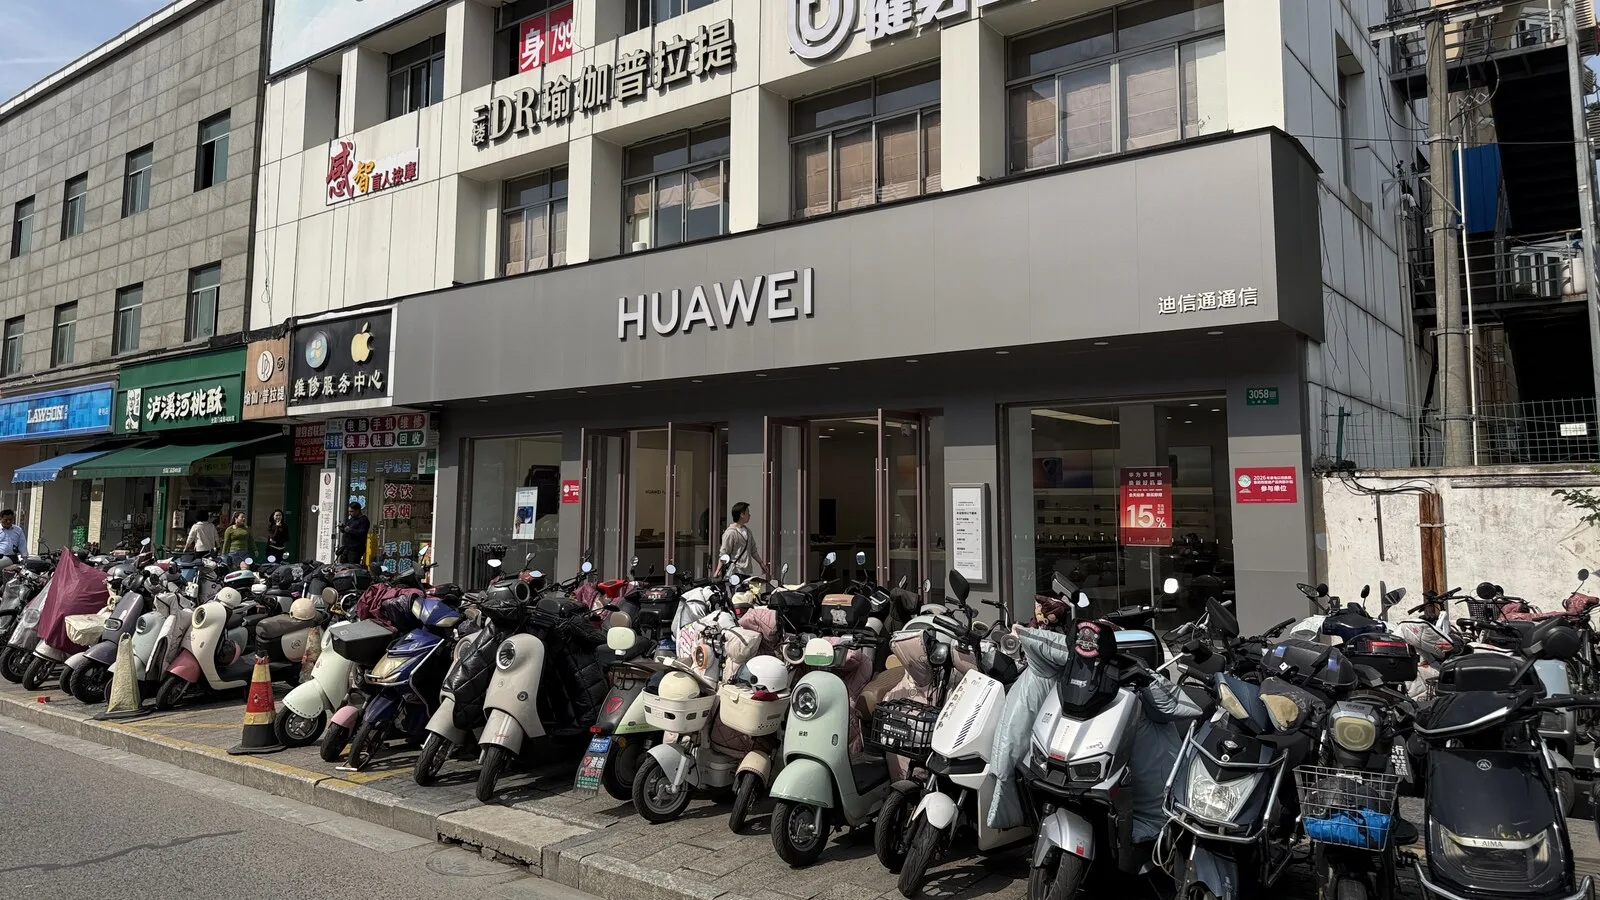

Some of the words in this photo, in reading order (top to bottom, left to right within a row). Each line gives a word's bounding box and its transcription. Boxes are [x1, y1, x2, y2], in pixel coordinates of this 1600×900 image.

[520, 28, 544, 70] 身
[551, 18, 573, 55] 799
[471, 104, 489, 146] 二楼
[371, 161, 417, 191] 盲人按摩
[617, 267, 814, 340] HUAWEI
[1158, 287, 1258, 315] 迪信通通信
[294, 370, 383, 398] 维修服务中心
[1248, 389, 1269, 399] 3058
[146, 385, 223, 422] 泸溪河桃酥
[27, 405, 65, 424] LAWSON
[347, 419, 367, 432] 电脑
[372, 416, 394, 431] 手机
[400, 415, 422, 429] 维修
[346, 435, 367, 448] 换屏
[372, 433, 394, 446] 贴膜
[400, 431, 421, 445] 回收
[350, 477, 367, 491] 手机
[384, 483, 413, 499] 冷饮
[383, 504, 412, 519] 香烟
[1126, 504, 1155, 528] 15
[1155, 516, 1167, 529] %
[384, 541, 412, 556] 手机
[382, 558, 413, 574] 维修
[1481, 840, 1504, 848] AIMA
